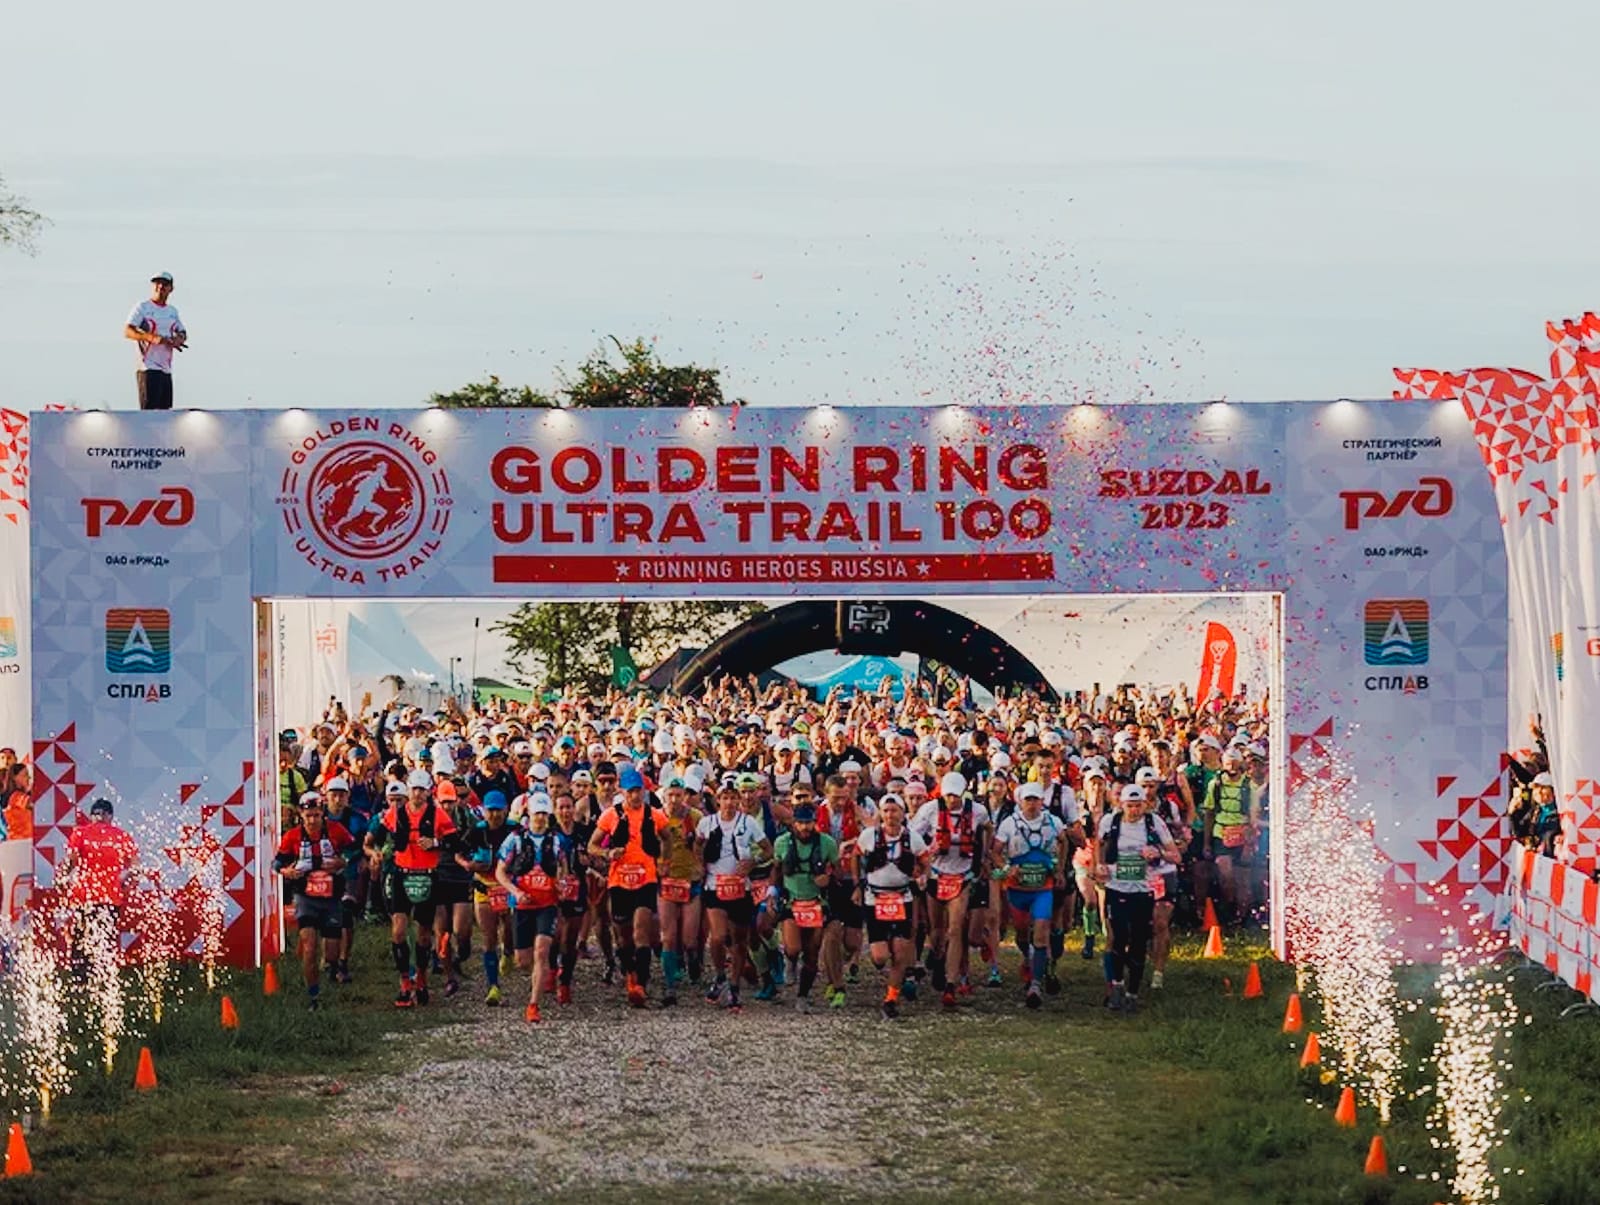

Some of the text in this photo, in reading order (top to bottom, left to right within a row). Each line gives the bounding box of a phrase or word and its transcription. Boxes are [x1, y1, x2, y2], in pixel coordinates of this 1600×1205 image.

[291, 416, 437, 466] GOLDEN RING
[1342, 436, 1442, 449] СТРАТЕГИЧЕСКИЙ
[86, 446, 185, 458] СТРАТЕГИЧЕСКИЙ
[1366, 450, 1419, 461] ПАРТНЁР
[111, 459, 162, 470] ПАРТНЁР
[490, 444, 1049, 494] GOLDEN RING
[1097, 468, 1272, 498] SUZDAL
[491, 500, 1051, 543] ULTRA TRAIL 100
[1140, 501, 1230, 529] 2023
[105, 555, 128, 566] ОАО
[295, 537, 441, 585] ULTRA TRAIL
[1364, 547, 1386, 557] ОАО
[639, 559, 908, 578] RUNNING HEROES RUSSIA
[107, 684, 172, 702] СПЛАВ
[1364, 673, 1430, 695] СПЛАВ
